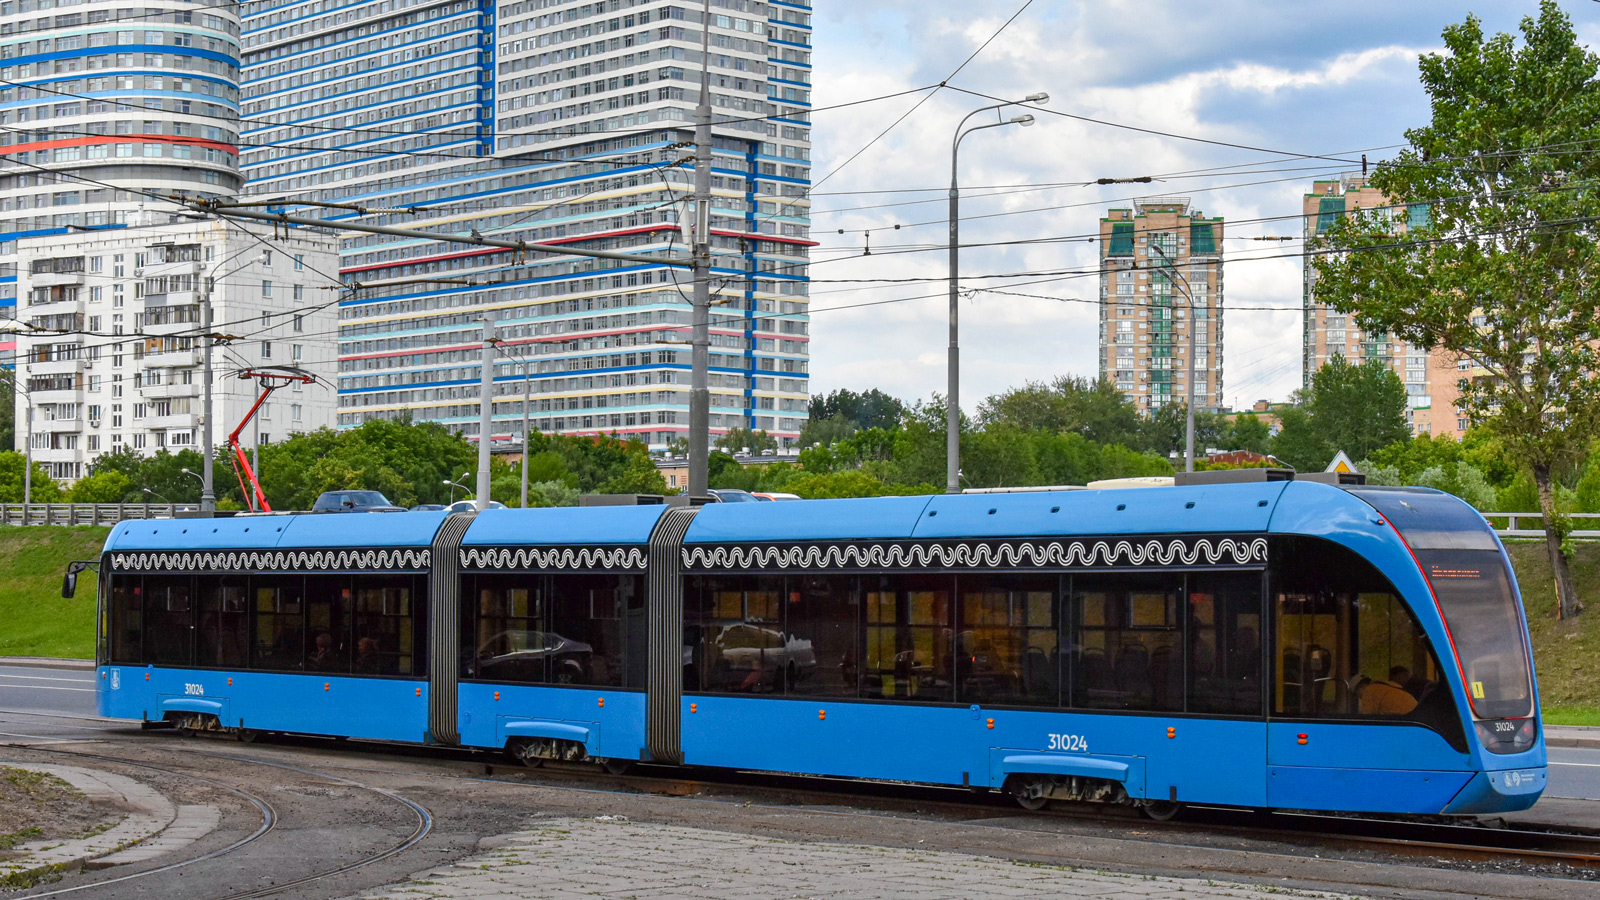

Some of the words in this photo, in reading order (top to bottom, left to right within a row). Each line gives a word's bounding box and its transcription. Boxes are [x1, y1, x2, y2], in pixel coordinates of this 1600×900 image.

[184, 683, 204, 695] 31024
[1495, 722, 1515, 732] 31024
[1048, 733, 1088, 751] 31024
